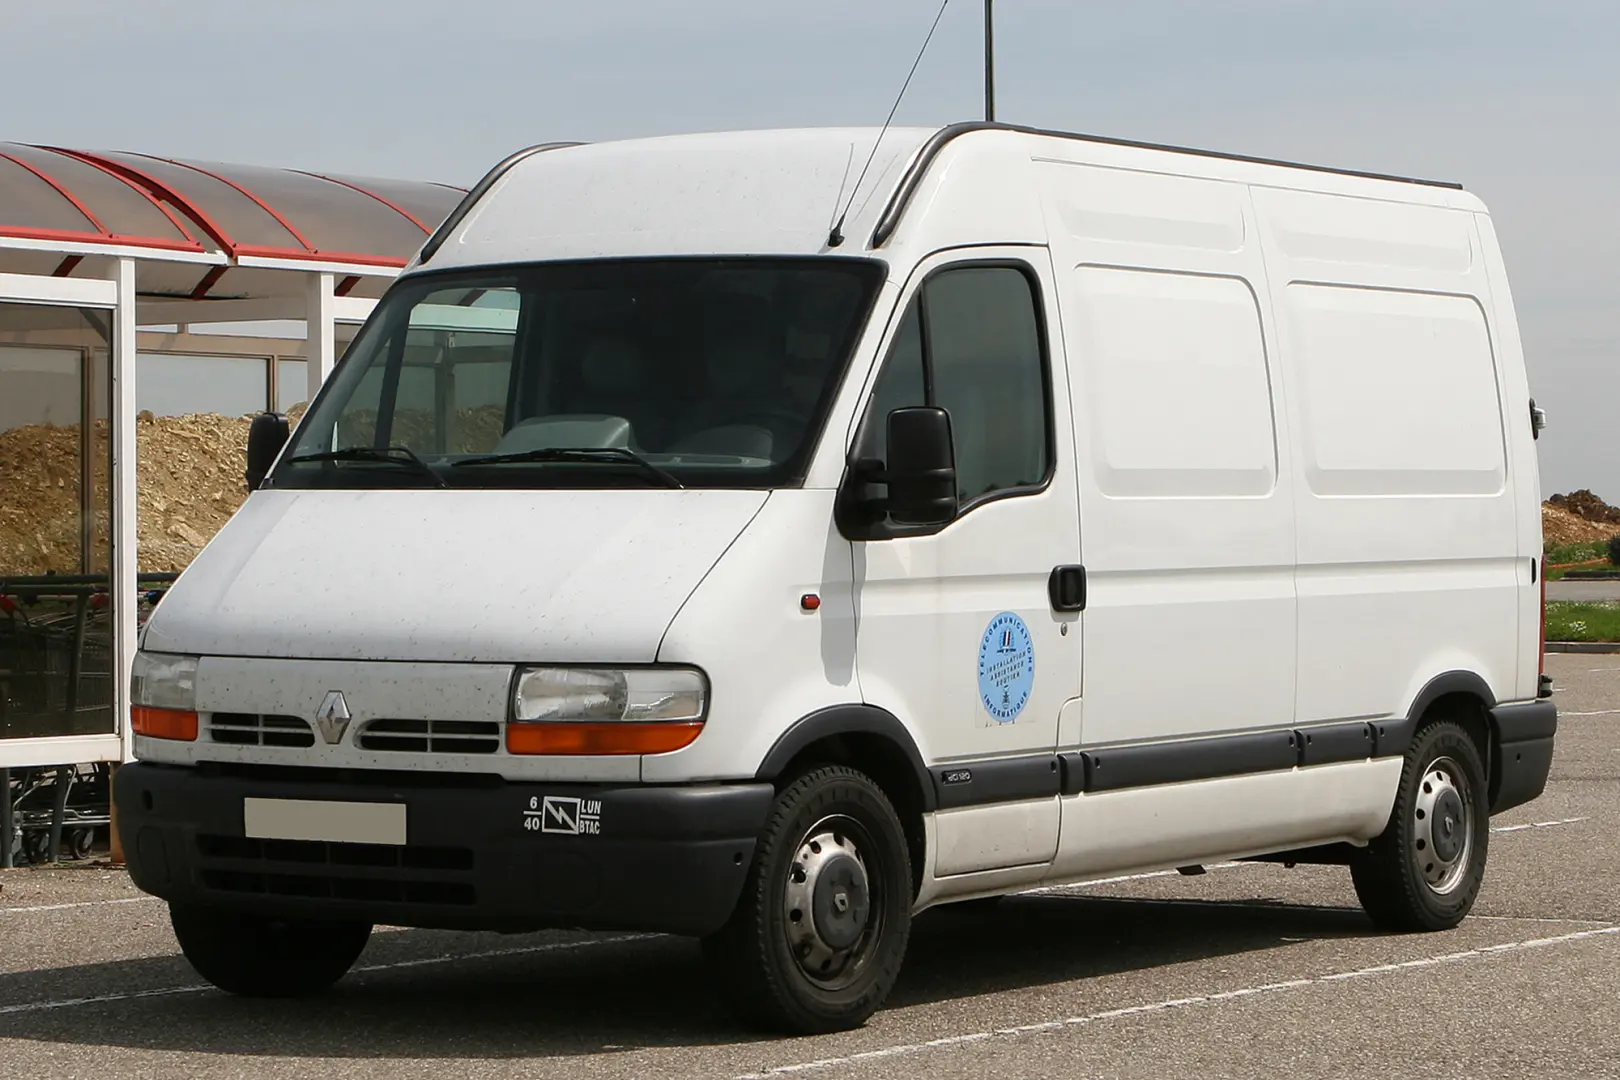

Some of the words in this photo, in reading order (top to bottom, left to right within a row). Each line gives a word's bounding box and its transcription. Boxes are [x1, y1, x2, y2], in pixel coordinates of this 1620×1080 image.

[983, 691, 1028, 718] INFORMATIQUE
[529, 796, 538, 810] 6
[581, 800, 602, 815] LUN
[523, 817, 540, 831] 40
[579, 819, 600, 835] BTAC
